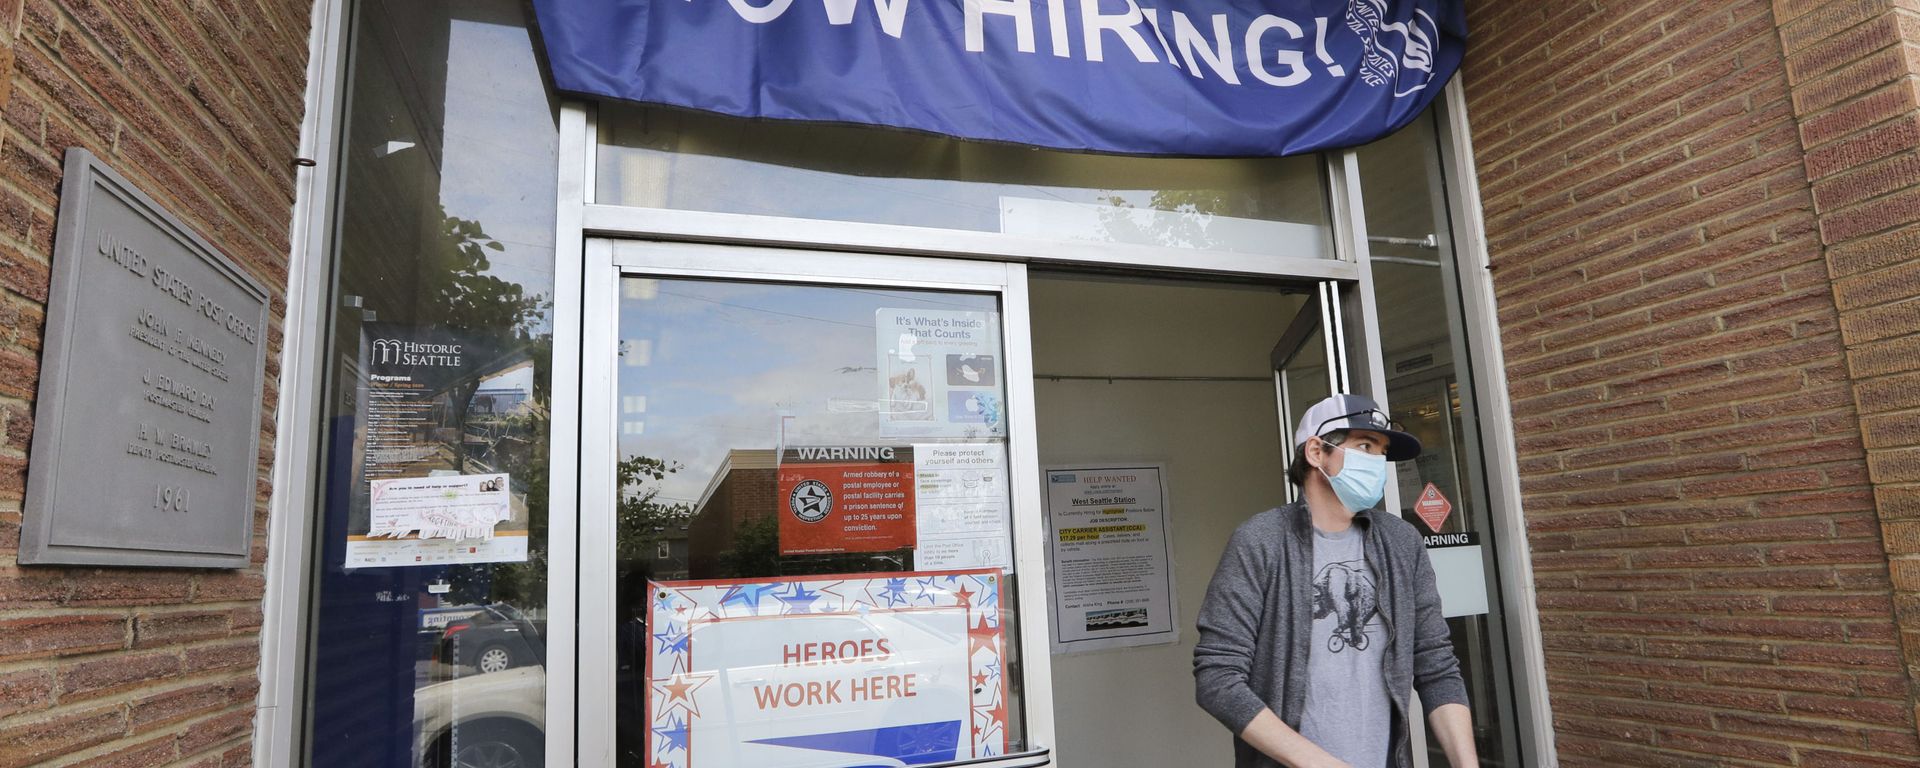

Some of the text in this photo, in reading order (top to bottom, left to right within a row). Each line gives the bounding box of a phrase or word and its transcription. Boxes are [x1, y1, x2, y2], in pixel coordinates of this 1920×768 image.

[964, 0, 1346, 87] HIRING!
[98, 228, 255, 345] UNITED STATES POST OFFICE
[896, 316, 981, 328] It's What's Inside
[138, 308, 168, 337] JOHN
[187, 335, 227, 366] KENNEDY
[908, 328, 971, 339] That Counts
[371, 374, 411, 382] Programs
[156, 373, 198, 403] EDWARD
[797, 447, 895, 460] WARNING
[959, 450, 984, 458] protect
[925, 457, 955, 466] yourself
[864, 471, 887, 479] robbery
[1083, 476, 1102, 484] HELP
[1104, 475, 1137, 483] WANTED
[843, 482, 861, 490] postal
[863, 482, 892, 490] employee
[153, 483, 190, 512] 1961
[843, 493, 862, 501] postal
[863, 492, 883, 500] facility
[1114, 496, 1136, 504] Station
[869, 513, 886, 521] years
[887, 513, 902, 521] upon
[1098, 525, 1126, 533] ASSISTANT
[1423, 533, 1469, 546] ARNING
[783, 638, 891, 668] HEROES
[753, 673, 917, 710] WORK HERE
